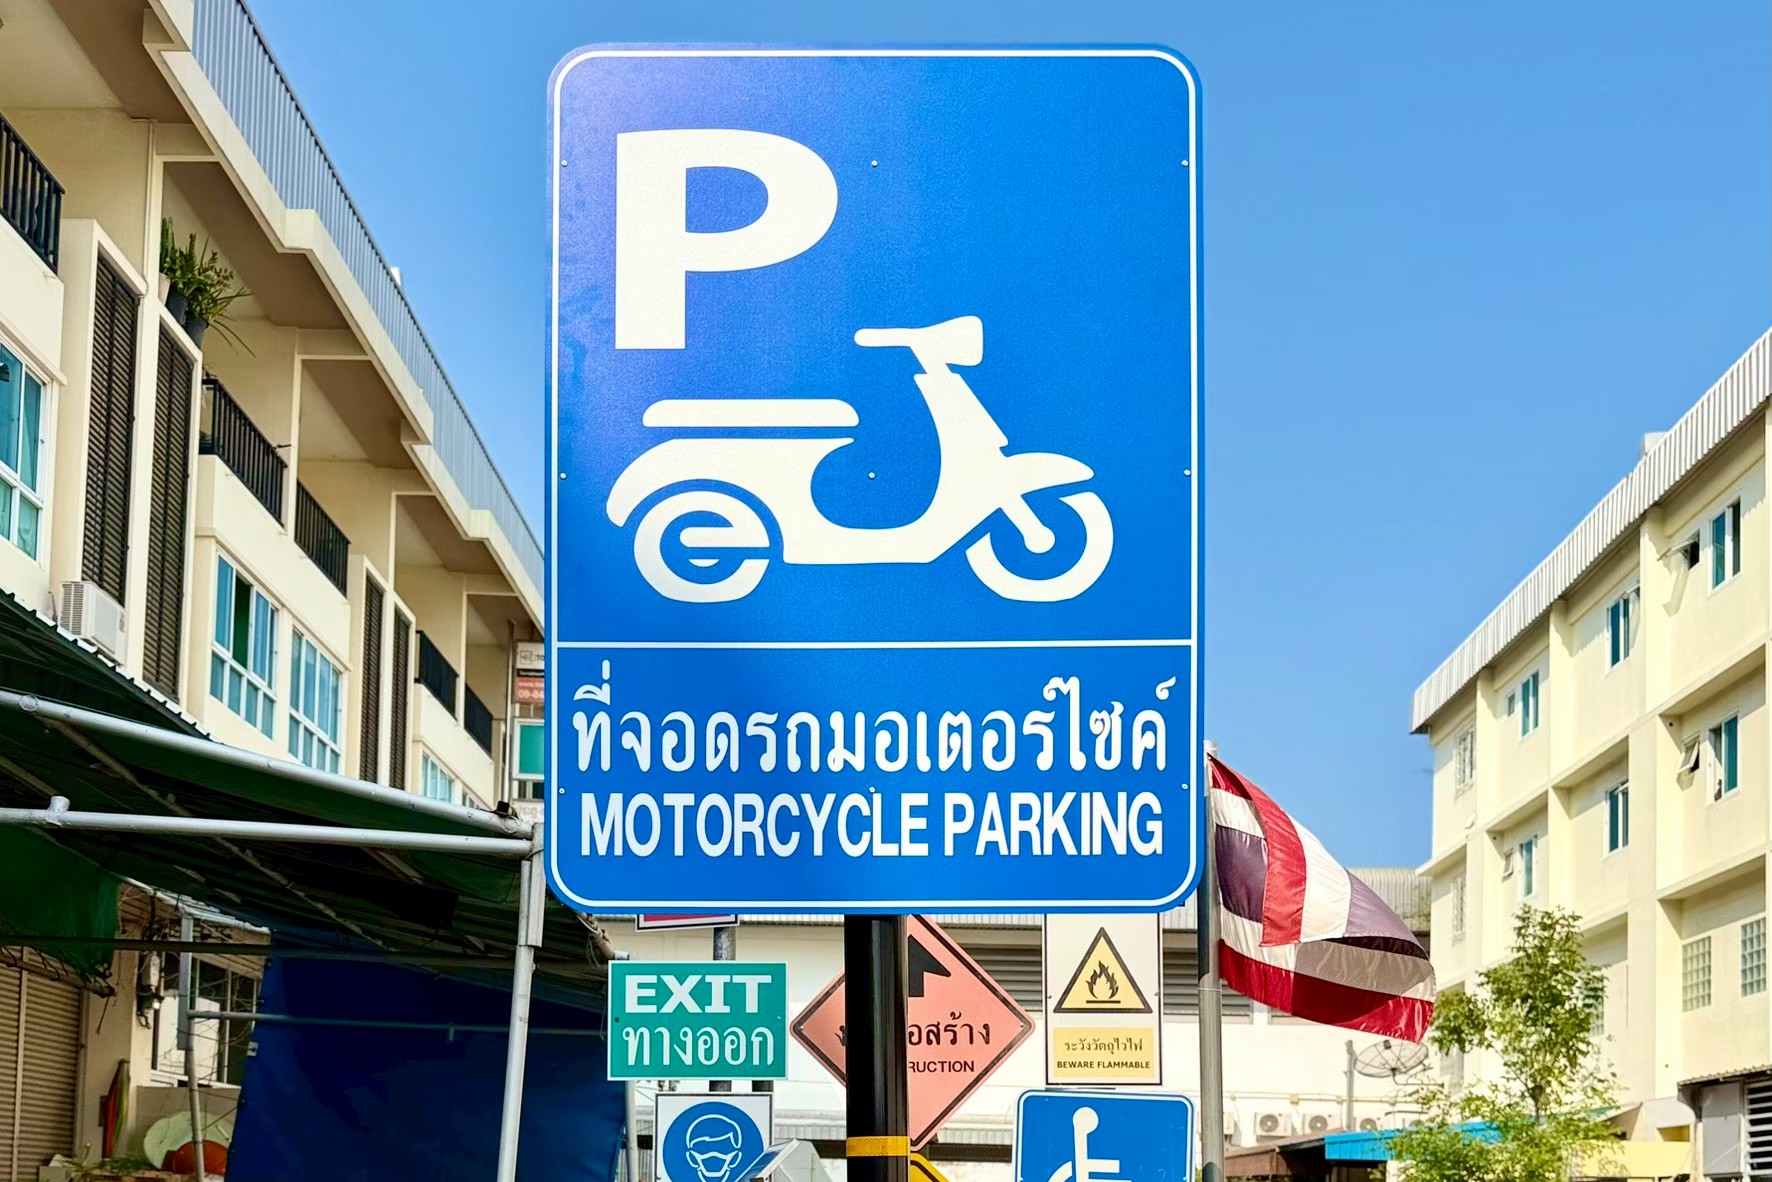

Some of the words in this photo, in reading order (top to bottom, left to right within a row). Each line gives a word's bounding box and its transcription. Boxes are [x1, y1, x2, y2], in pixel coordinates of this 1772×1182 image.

[614, 128, 839, 350] P
[573, 660, 1177, 773] ที่จอดรถมอเตอร์ไซค์
[581, 792, 929, 857] MOTORCYCLE
[944, 791, 1163, 856] PARKING
[625, 974, 772, 1014] EXIT
[622, 1026, 774, 1066] ทางออก
[1057, 1061, 1095, 1069] BEWARE
[1097, 1061, 1151, 1069] FLAMMABLE
[1064, 1037, 1143, 1055] ระวังวัตถุไวไฟ
[909, 1060, 975, 1073] RUCTION
